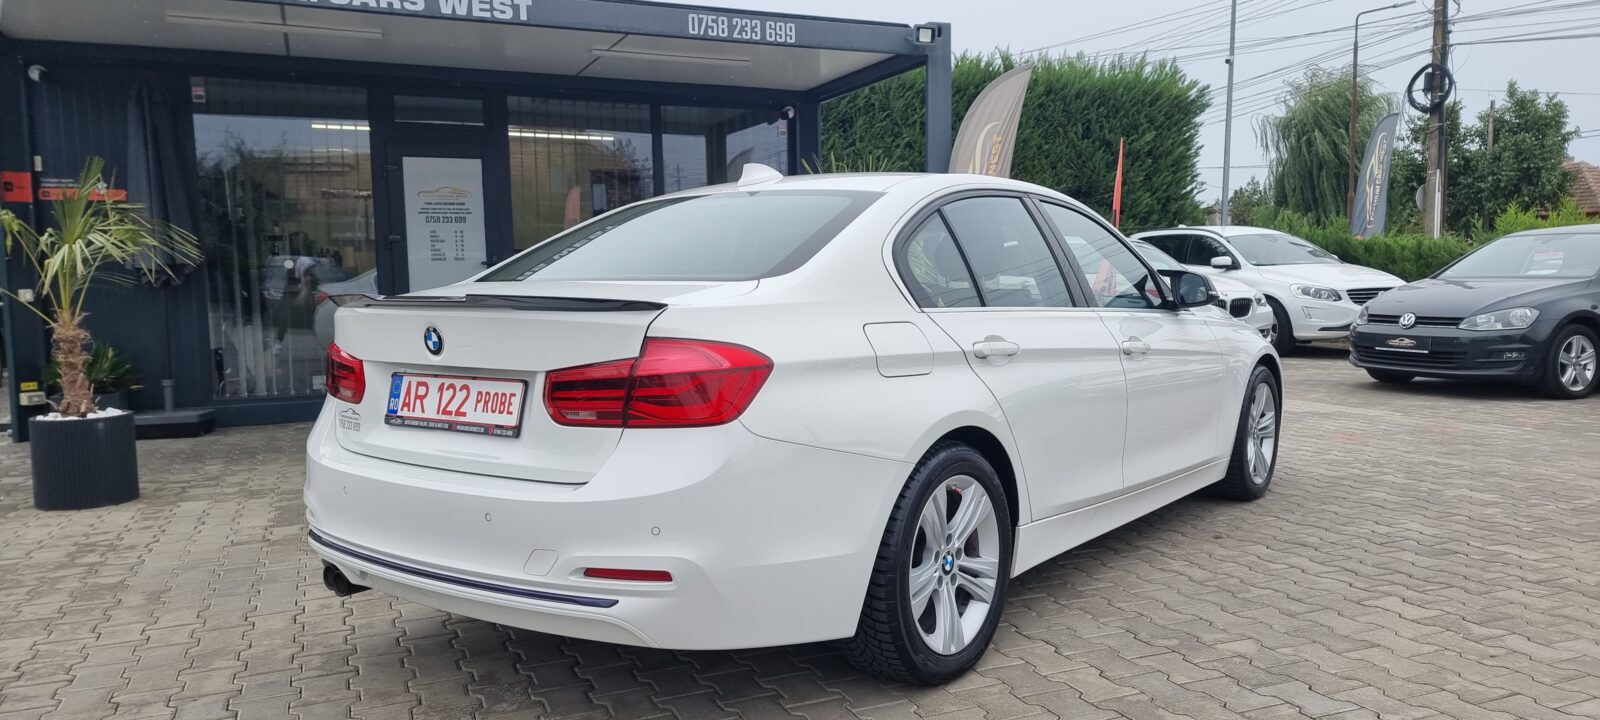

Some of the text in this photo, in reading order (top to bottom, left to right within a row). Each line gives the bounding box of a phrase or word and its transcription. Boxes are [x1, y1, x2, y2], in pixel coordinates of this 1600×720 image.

[438, 0, 532, 21] WEST
[688, 13, 796, 43] 0758 233 699
[389, 397, 399, 411] RO
[400, 380, 517, 417] AR 122 PROBE
